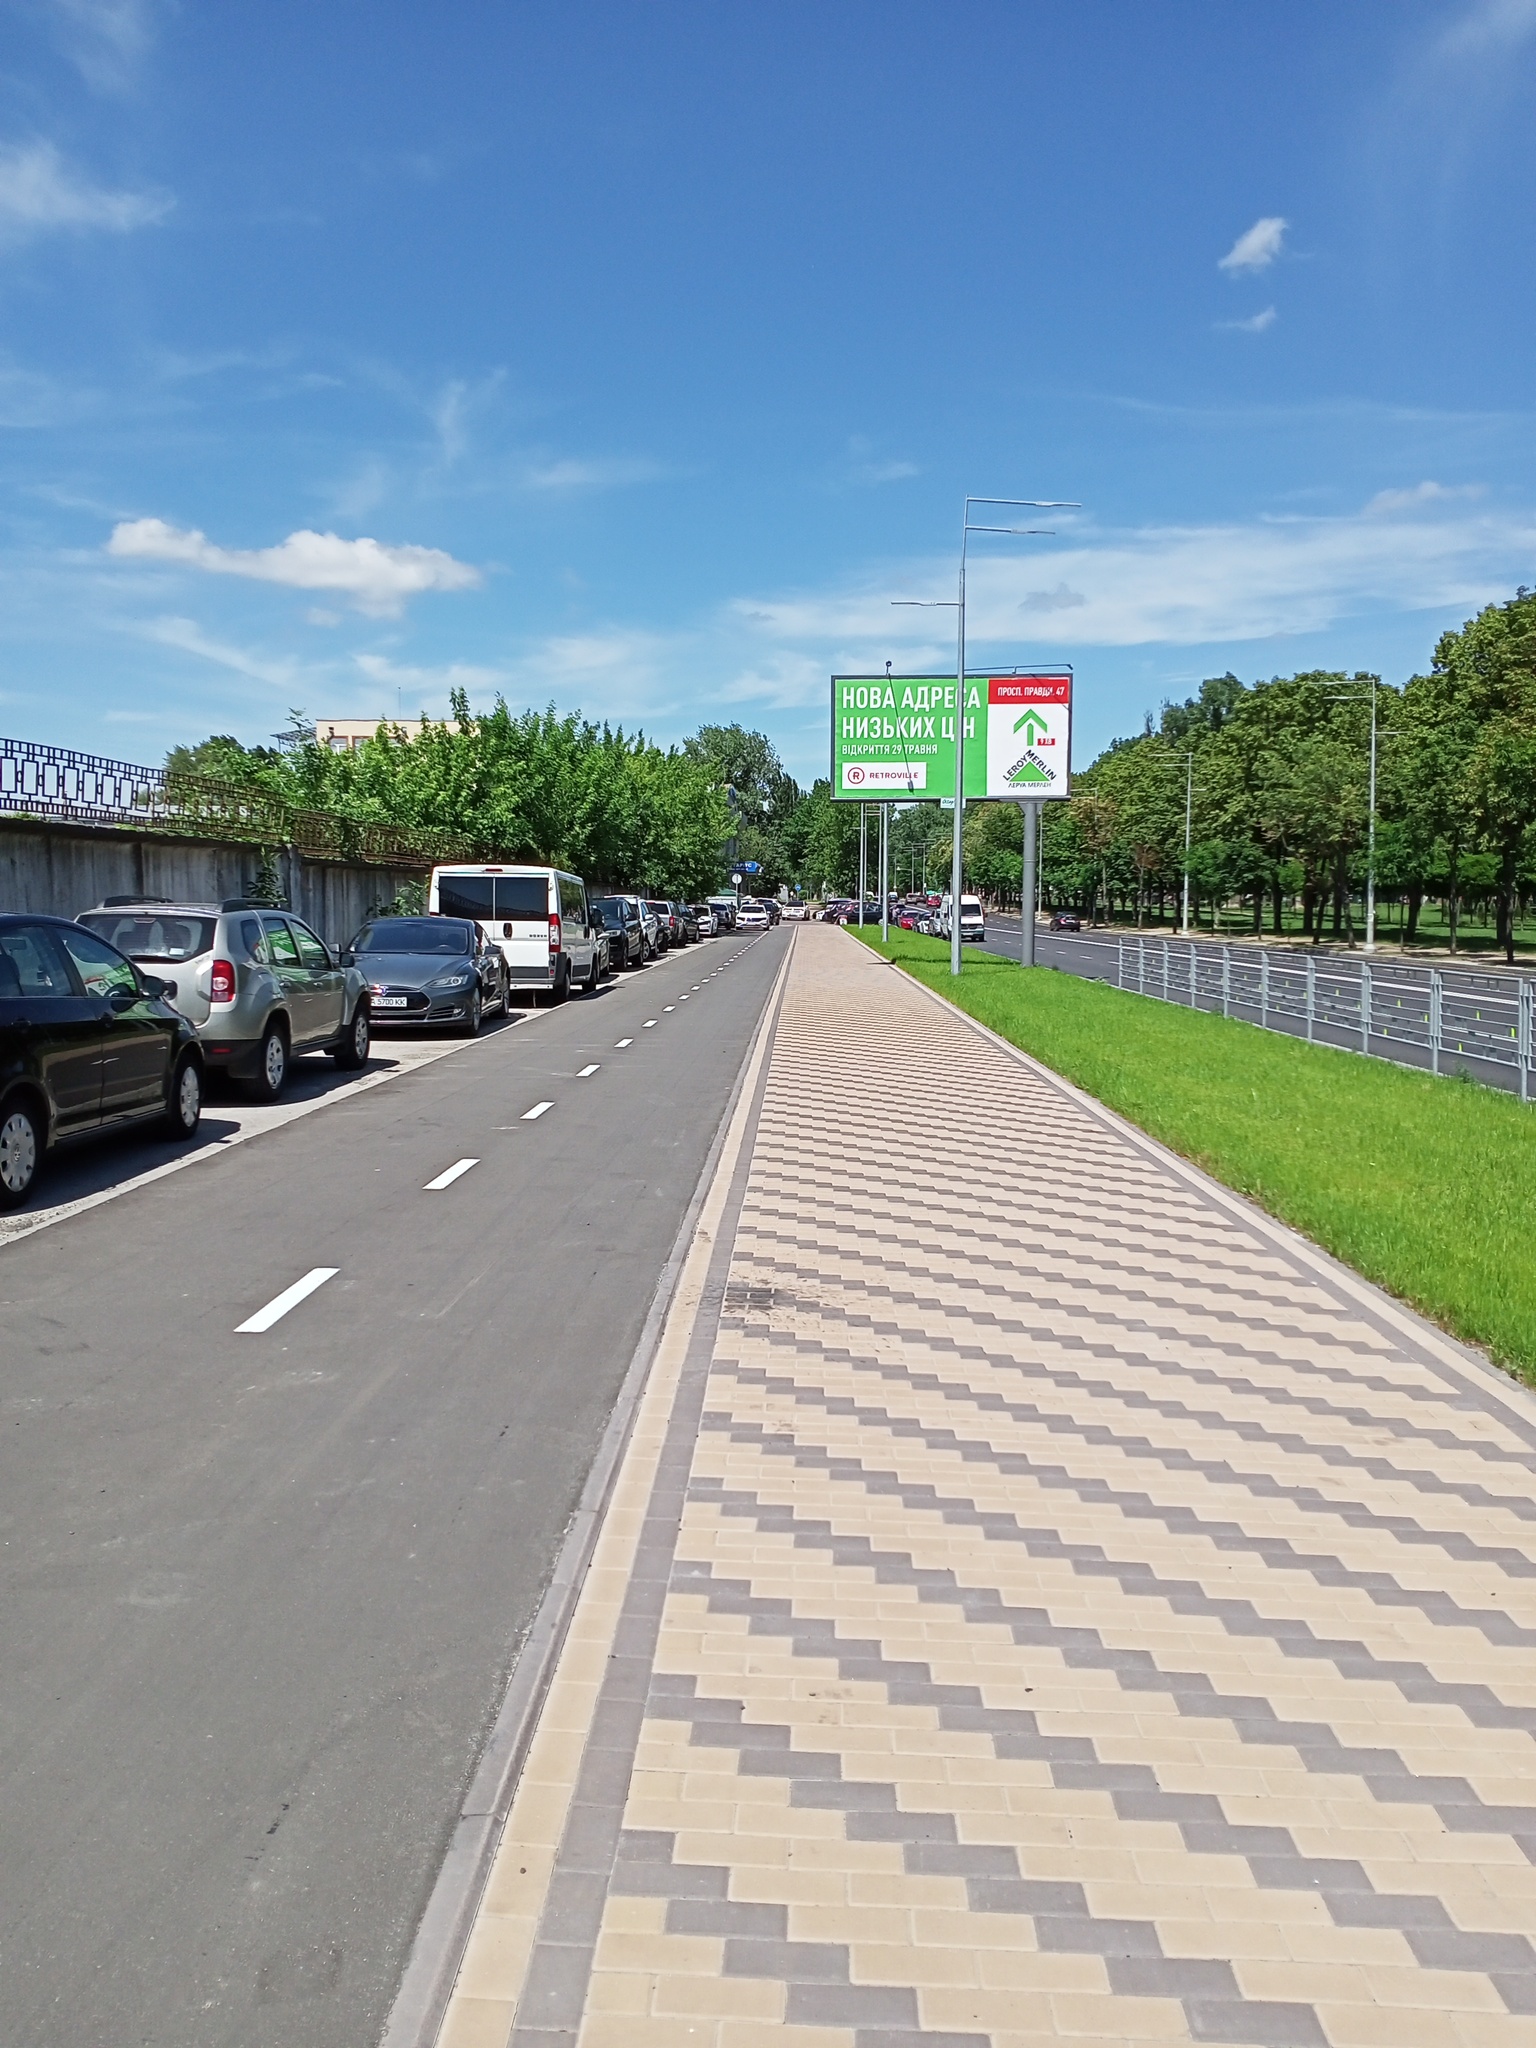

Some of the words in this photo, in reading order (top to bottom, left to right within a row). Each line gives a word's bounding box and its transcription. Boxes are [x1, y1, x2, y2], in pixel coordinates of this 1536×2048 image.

[842, 686, 895, 709] НОВА
[997, 686, 1023, 697] ПРОСП.
[1056, 686, 1065, 696] 47
[842, 716, 935, 739] НИЗЬКИХ
[941, 716, 975, 742] ЦН
[842, 744, 890, 756] ВІДКРИТТЯ
[892, 744, 902, 755] 29
[903, 744, 938, 755] ТРАВНЯ
[1003, 755, 1028, 781] LEROY
[1025, 749, 1057, 781] MERLIN
[852, 771, 860, 780] R
